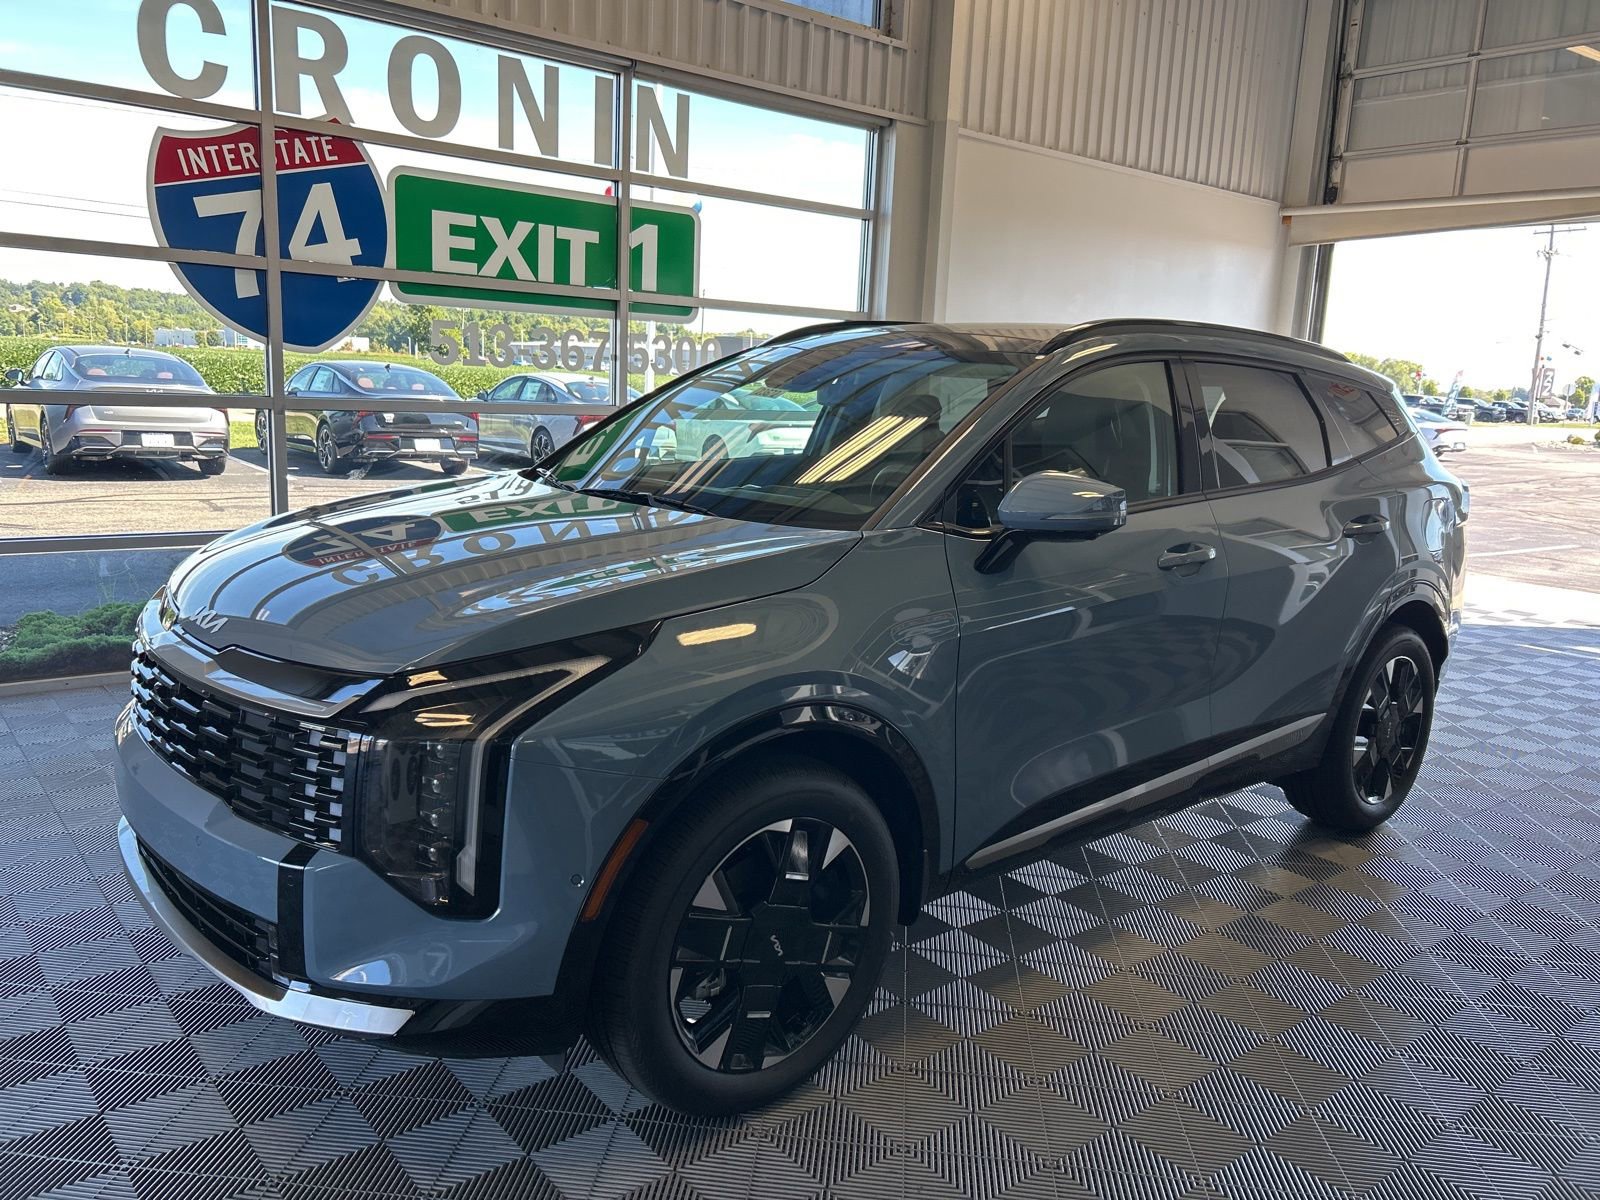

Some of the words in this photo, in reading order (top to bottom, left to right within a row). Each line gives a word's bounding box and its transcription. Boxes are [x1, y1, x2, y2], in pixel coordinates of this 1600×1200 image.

[137, 0, 691, 179] CRONIN
[177, 136, 338, 176] INTERTATE
[193, 182, 362, 298] 74
[432, 209, 599, 287] EXIT
[629, 223, 658, 292] 1
[430, 320, 723, 375] 513-3675300
